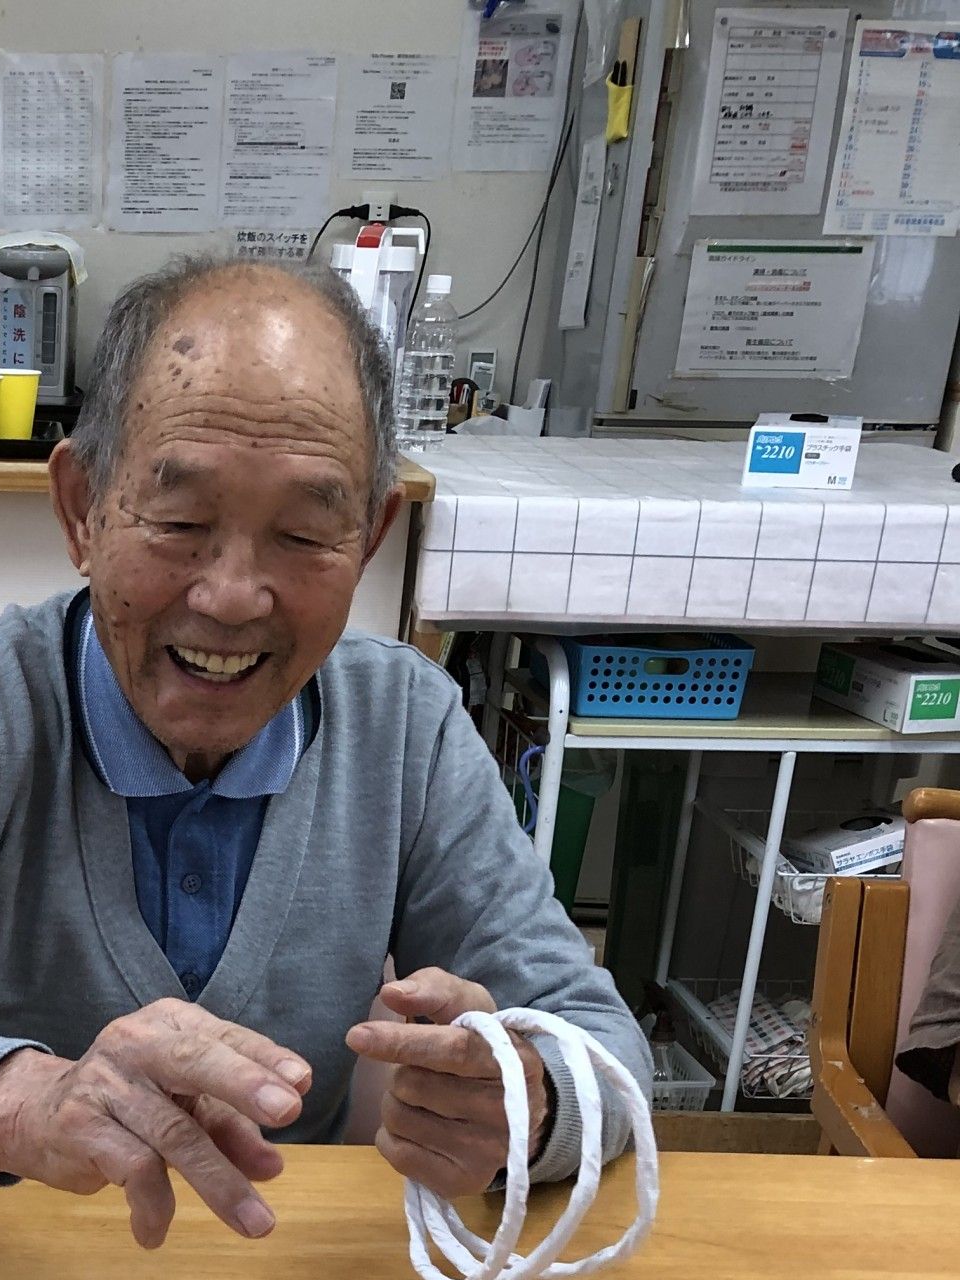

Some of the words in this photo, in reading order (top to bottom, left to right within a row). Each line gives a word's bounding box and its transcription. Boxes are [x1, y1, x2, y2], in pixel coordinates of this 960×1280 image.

[237, 231, 308, 244] 炊飯のスイッチを
[806, 443, 852, 453] プラスチック手袋
[827, 476, 837, 485] M
